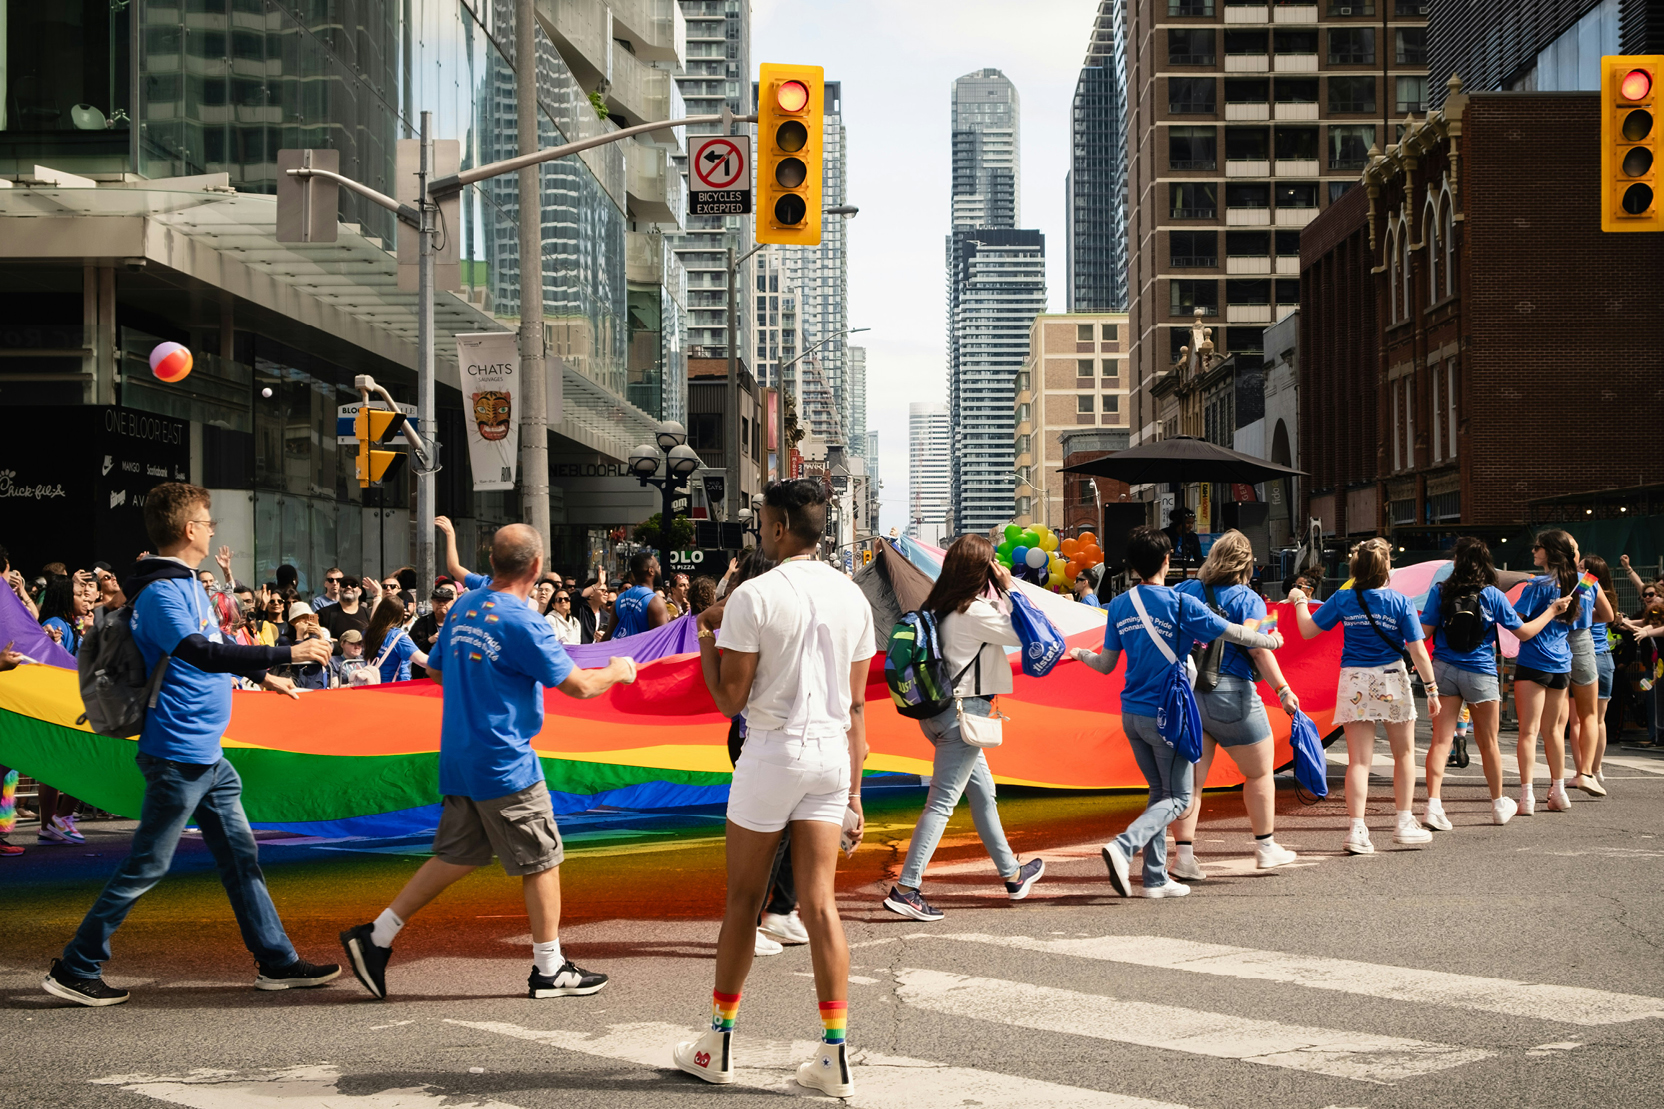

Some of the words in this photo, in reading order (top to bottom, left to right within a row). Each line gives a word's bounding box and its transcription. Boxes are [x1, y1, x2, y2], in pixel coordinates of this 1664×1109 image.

[698, 192, 742, 202] BICYCLES
[697, 204, 743, 213] EXCEPTED
[467, 363, 513, 376] CHATS
[105, 409, 127, 435] ONE
[129, 414, 161, 442] BLOOR
[162, 421, 183, 445] EAST
[122, 461, 140, 473] MANGO
[549, 463, 638, 477] NEBLOORLA
[0, 476, 66, 500] Chick-fil-A
[1238, 484, 1249, 501] GER
[1271, 487, 1282, 505] fido
[1154, 617, 1173, 630] Pride
[483, 632, 502, 651] Pride
[1033, 641, 1060, 671] llstate
